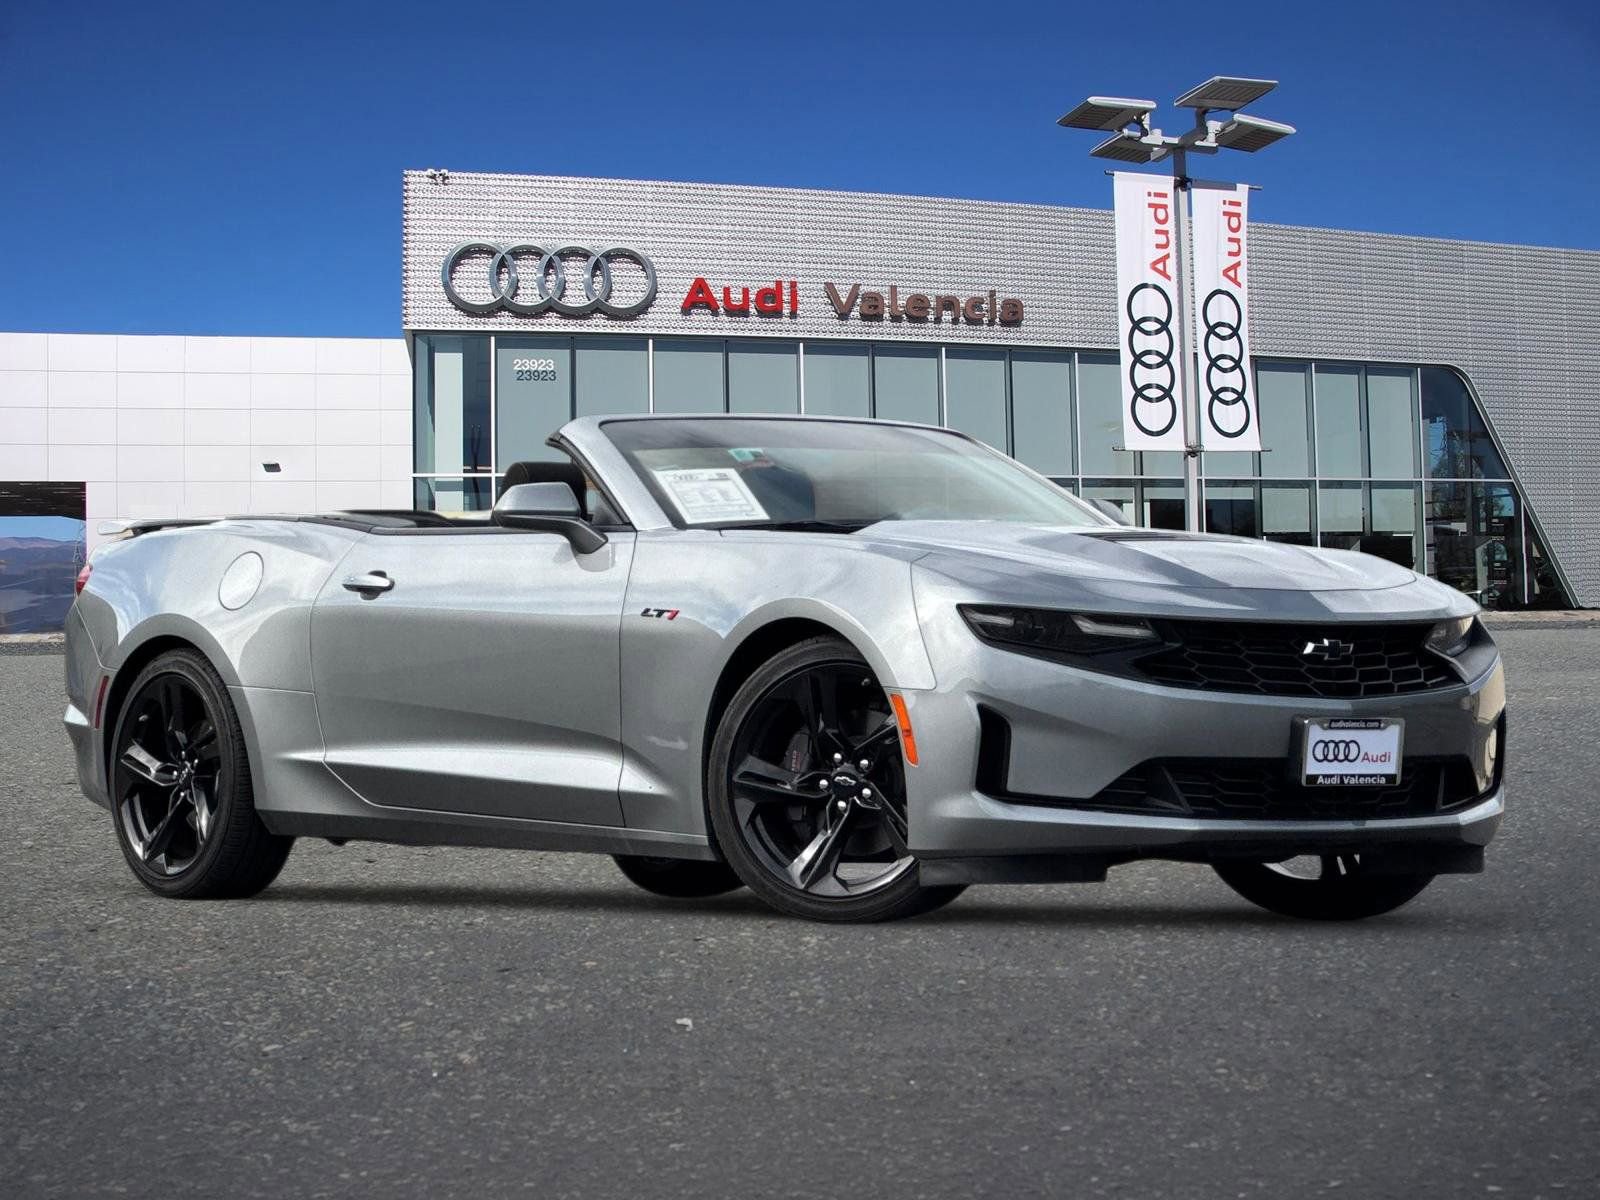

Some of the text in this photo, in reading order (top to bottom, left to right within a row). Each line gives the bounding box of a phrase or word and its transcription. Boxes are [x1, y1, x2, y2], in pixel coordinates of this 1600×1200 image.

[1147, 191, 1171, 282] Audi
[1222, 199, 1242, 289] Audi
[682, 277, 1024, 325] Audi Valencia
[513, 359, 554, 370] 23923
[516, 370, 557, 381] 23923
[641, 607, 680, 620] LT1
[1361, 752, 1391, 763] Audi
[1317, 775, 1386, 785] Audi Valencia
